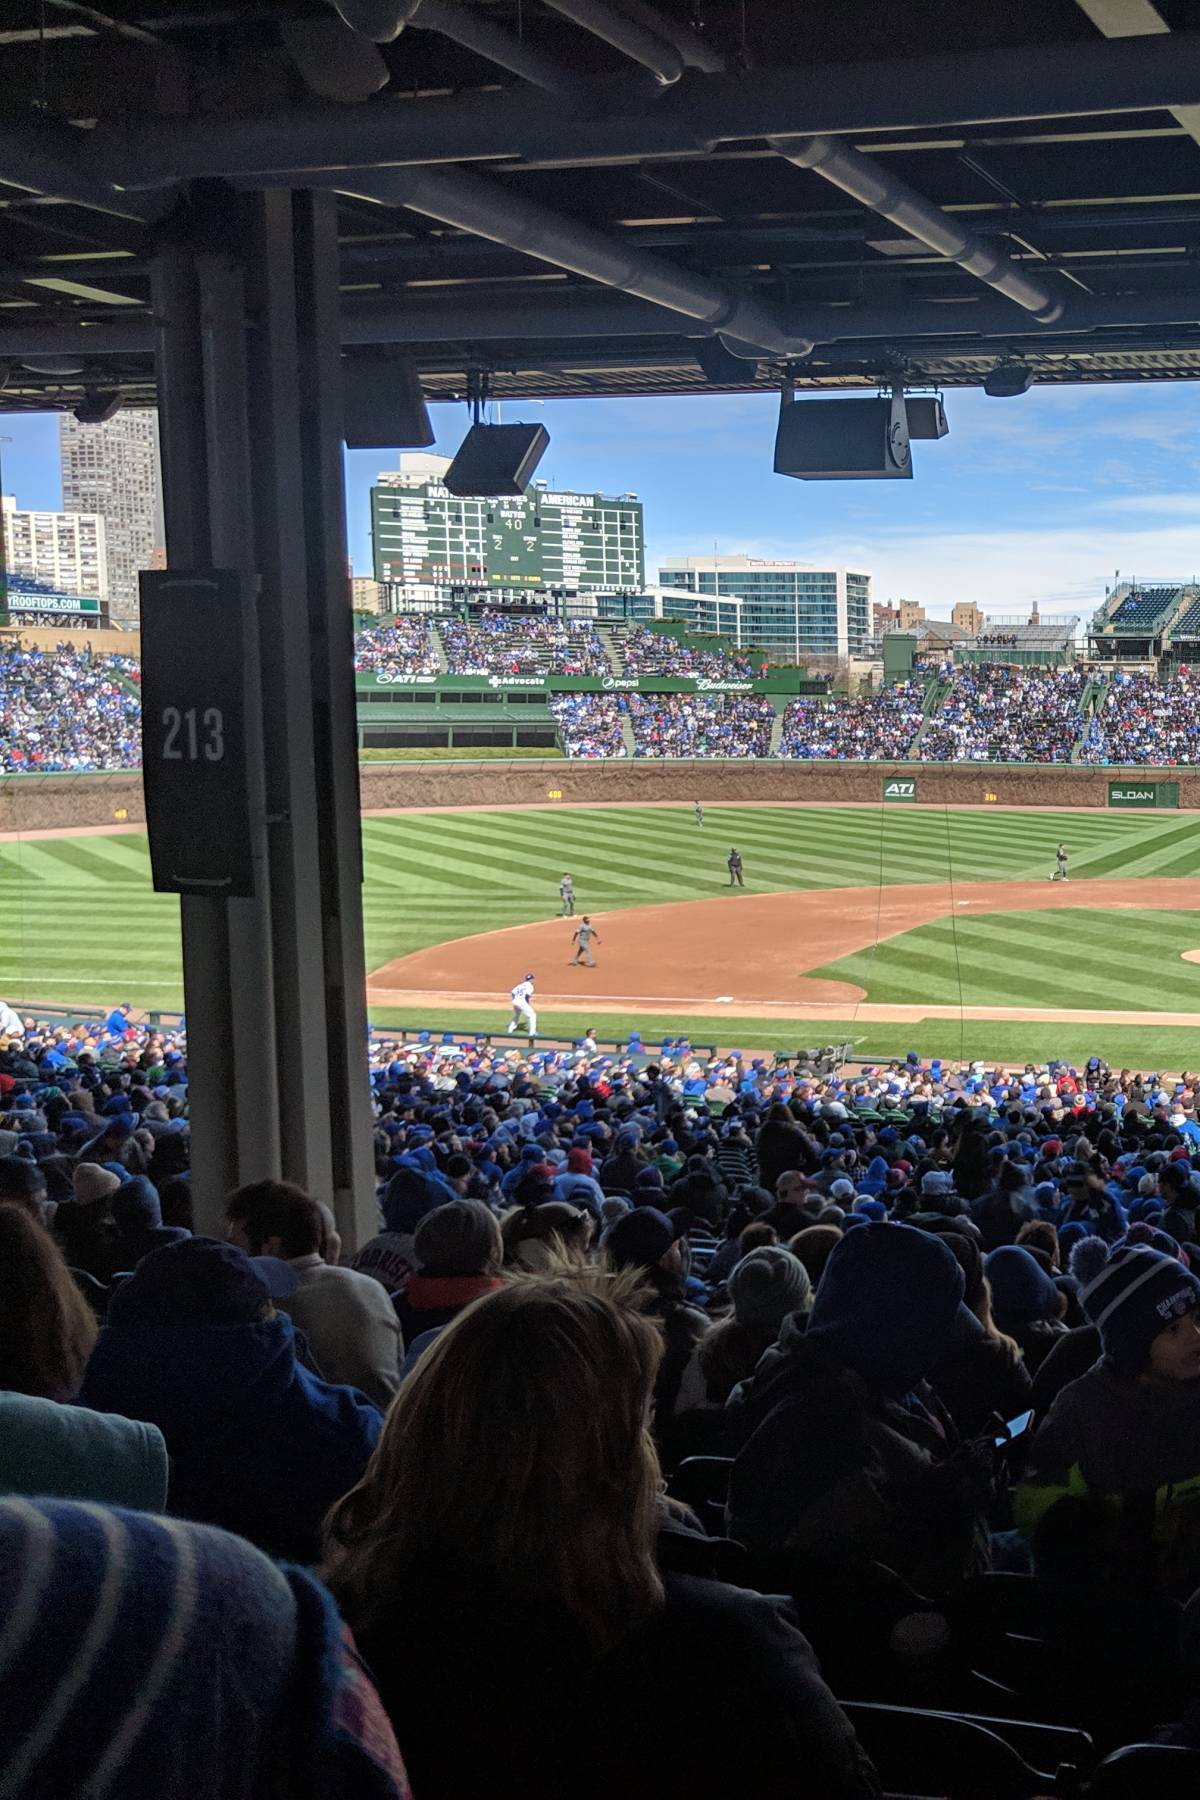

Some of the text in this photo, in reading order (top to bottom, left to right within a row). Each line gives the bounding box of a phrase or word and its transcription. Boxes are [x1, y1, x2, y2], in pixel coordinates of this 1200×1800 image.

[541, 494, 594, 507] AMERICAN
[500, 510, 526, 518] BATTER
[505, 519, 522, 530] 40
[494, 540, 502, 550] 2
[526, 541, 534, 552] 2
[392, 674, 416, 684] ATI
[502, 677, 544, 685] Advocate
[614, 680, 638, 688] pepsi
[696, 677, 753, 690] Budweiser
[162, 706, 225, 761] 213
[886, 784, 914, 793] ATI
[1112, 791, 1153, 799] SLOAN
